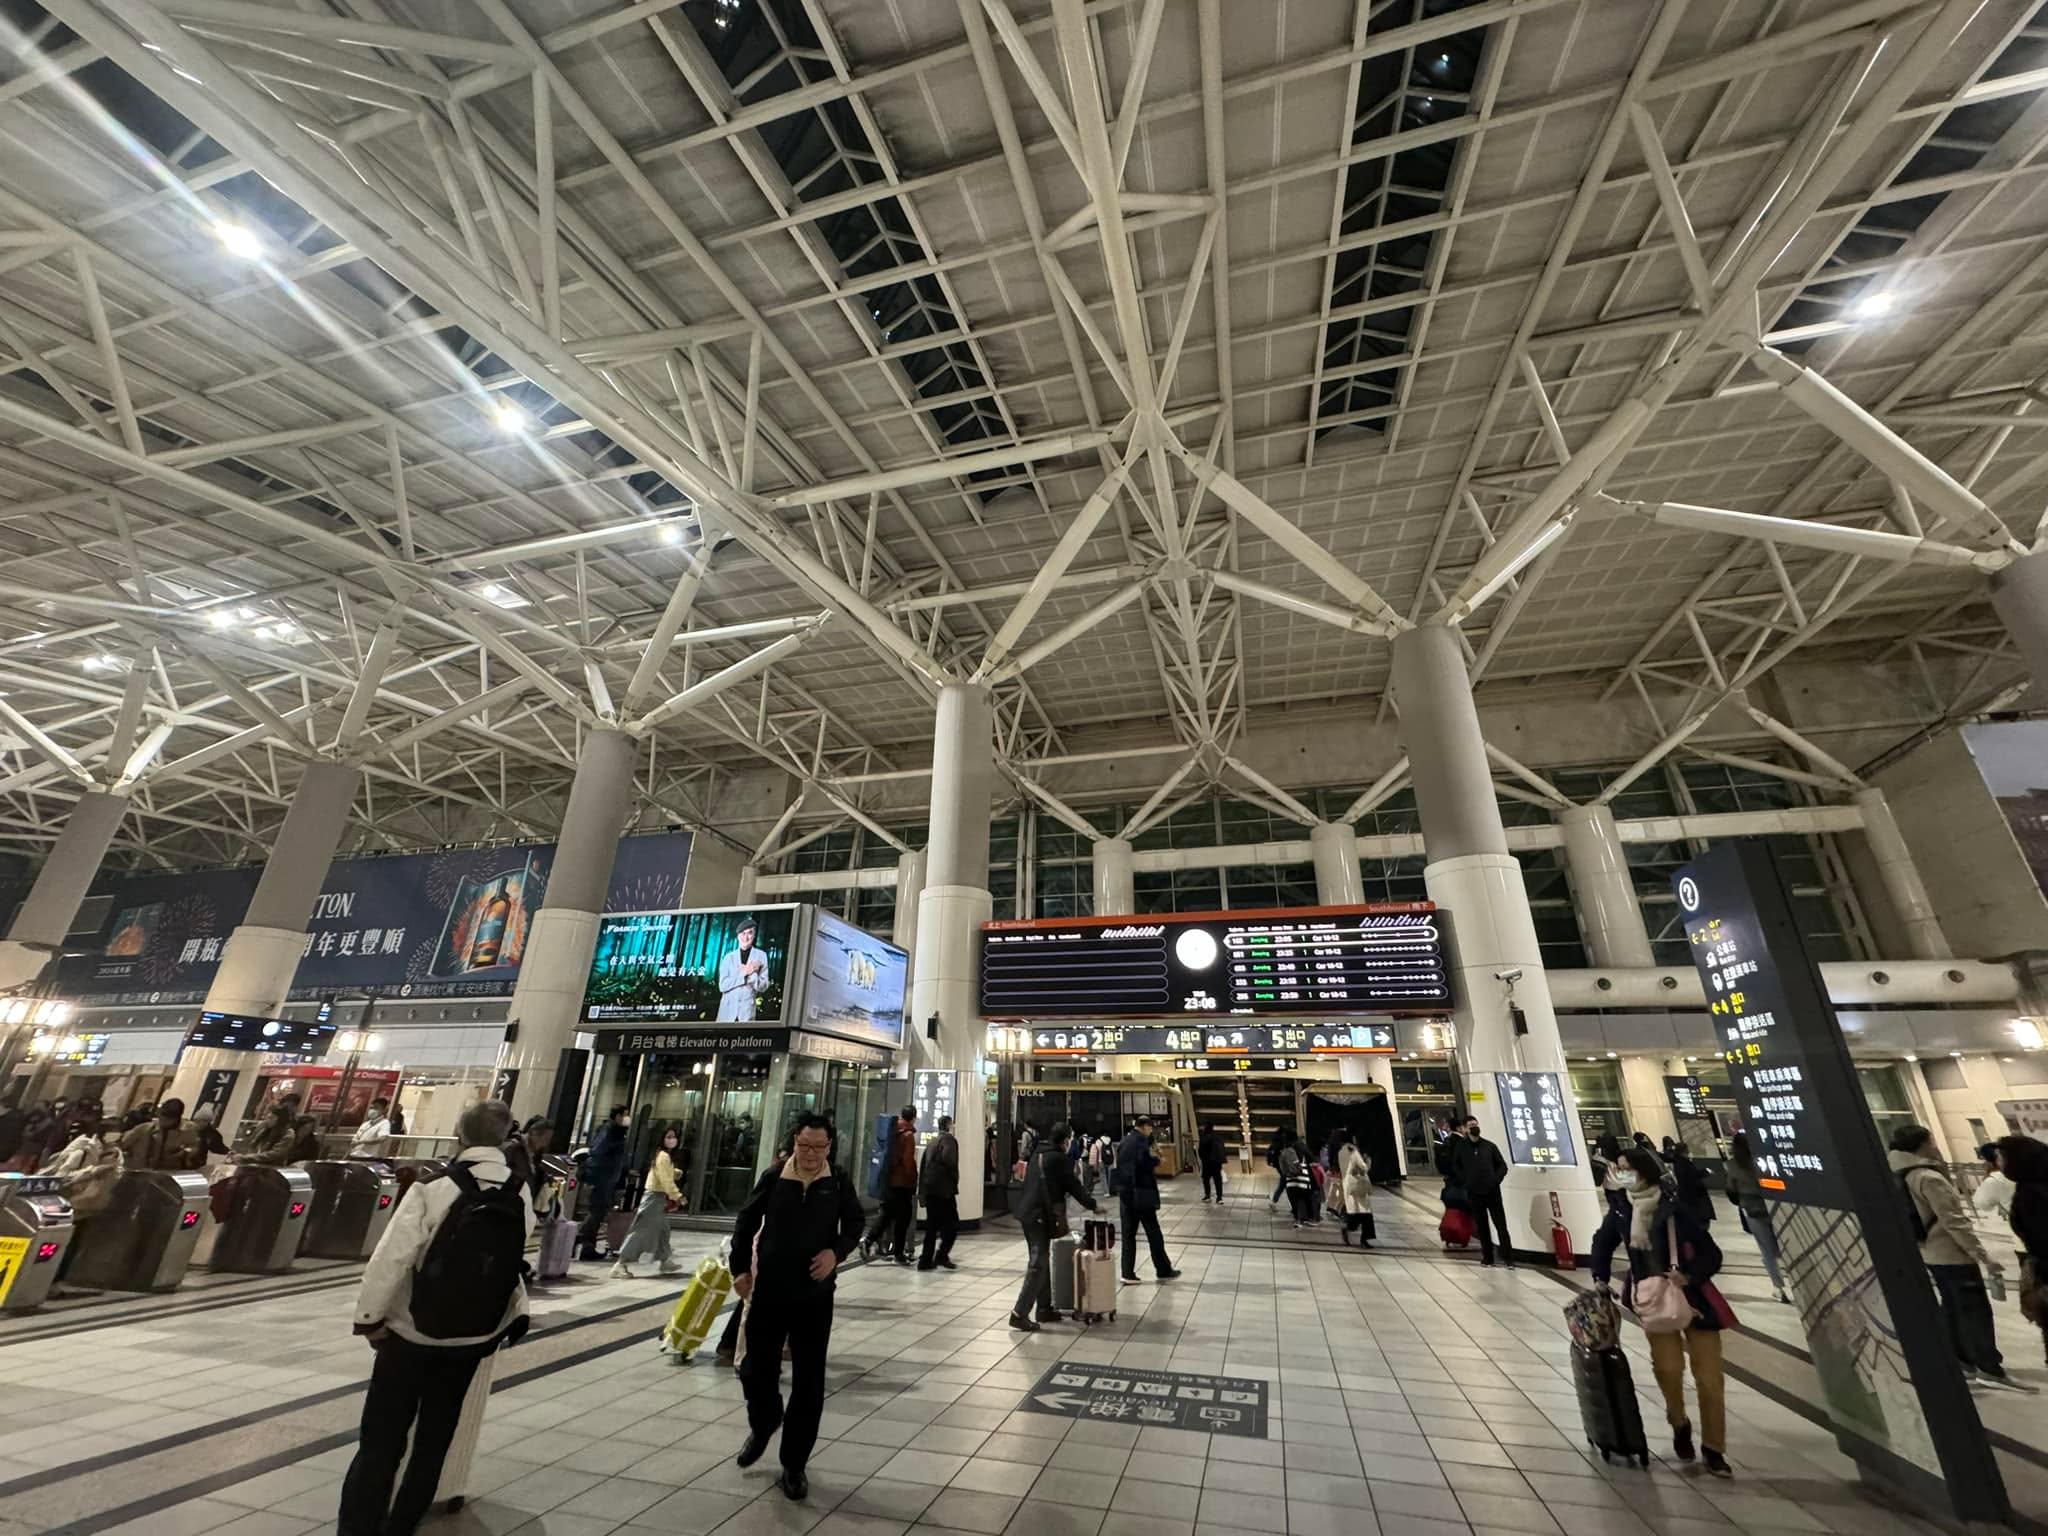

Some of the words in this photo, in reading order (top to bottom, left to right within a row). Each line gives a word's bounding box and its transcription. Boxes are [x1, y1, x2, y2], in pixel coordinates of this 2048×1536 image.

[1699, 928, 1708, 942] 2
[1184, 997, 1216, 1009] 23:08
[617, 1034, 625, 1050] 1
[630, 1035, 677, 1049] 月台電梯
[680, 1036, 716, 1048] Elevator
[719, 1037, 729, 1048] to
[731, 1036, 772, 1049] platform
[1091, 1031, 1104, 1050] 2
[1104, 1030, 1123, 1042] 出口
[1165, 1030, 1179, 1049] 4
[1180, 1030, 1200, 1042] 出口
[1272, 1029, 1284, 1048] 5
[1286, 1029, 1305, 1041] 出口
[1735, 1048, 1743, 1064] 5
[1745, 1043, 1760, 1056] 出口
[212, 1086, 223, 1101] 1
[1549, 1147, 1560, 1162] 5
